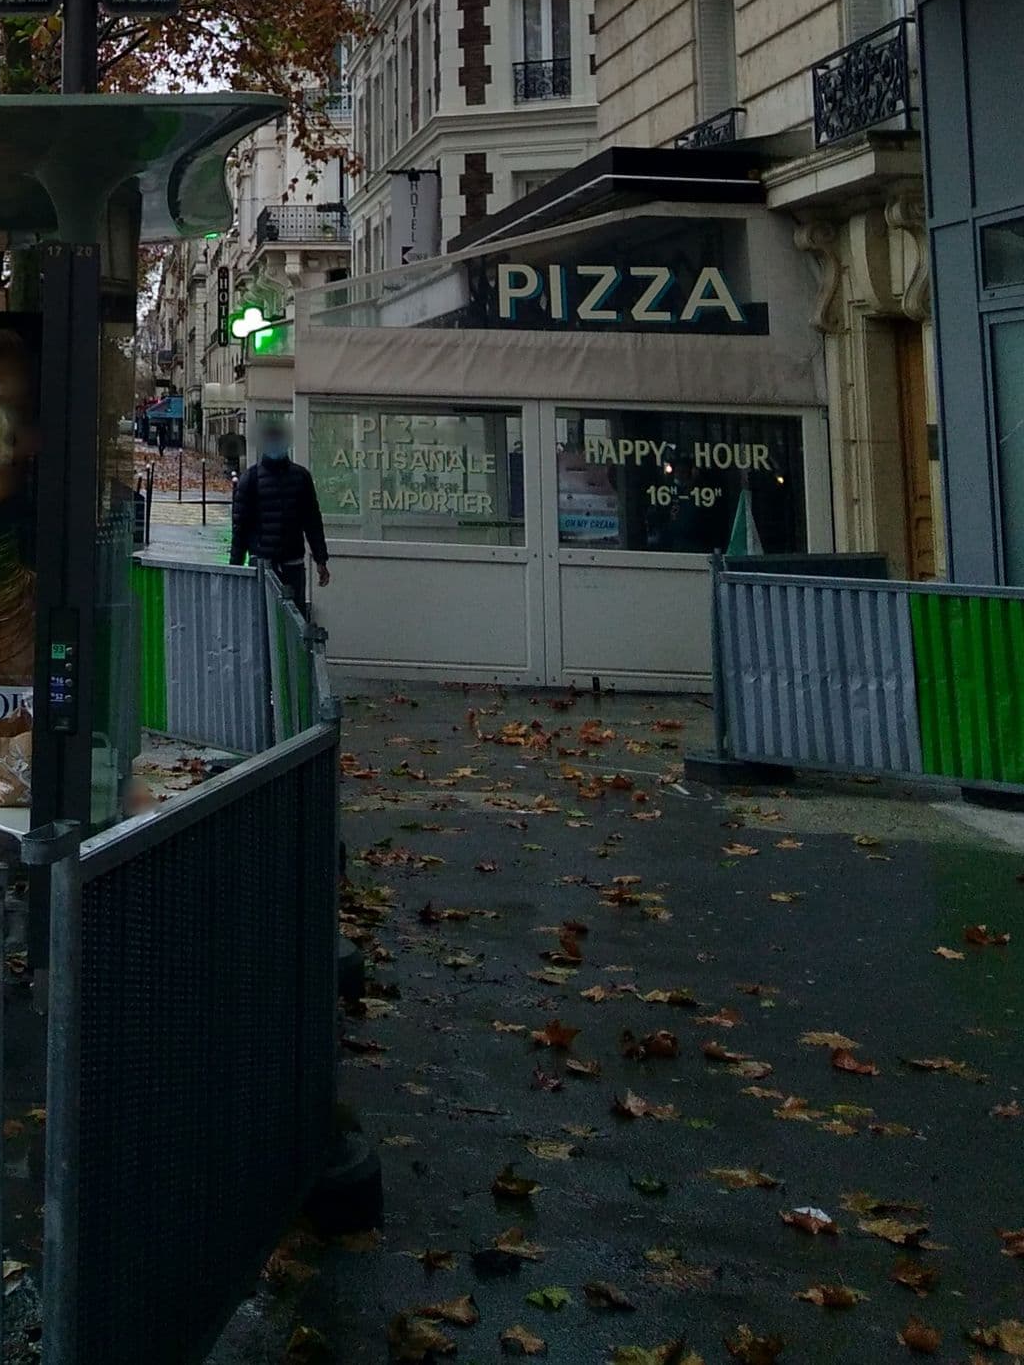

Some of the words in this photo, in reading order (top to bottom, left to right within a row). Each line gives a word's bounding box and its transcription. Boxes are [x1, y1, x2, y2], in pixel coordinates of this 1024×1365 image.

[498, 264, 745, 322] PIZZA
[332, 448, 496, 474] ARTISANALE
[584, 439, 667, 466] HAPPY
[694, 442, 773, 471] HOUR
[339, 489, 360, 509] A
[369, 490, 494, 514] EMPORTER
[53, 645, 64, 654] 93
